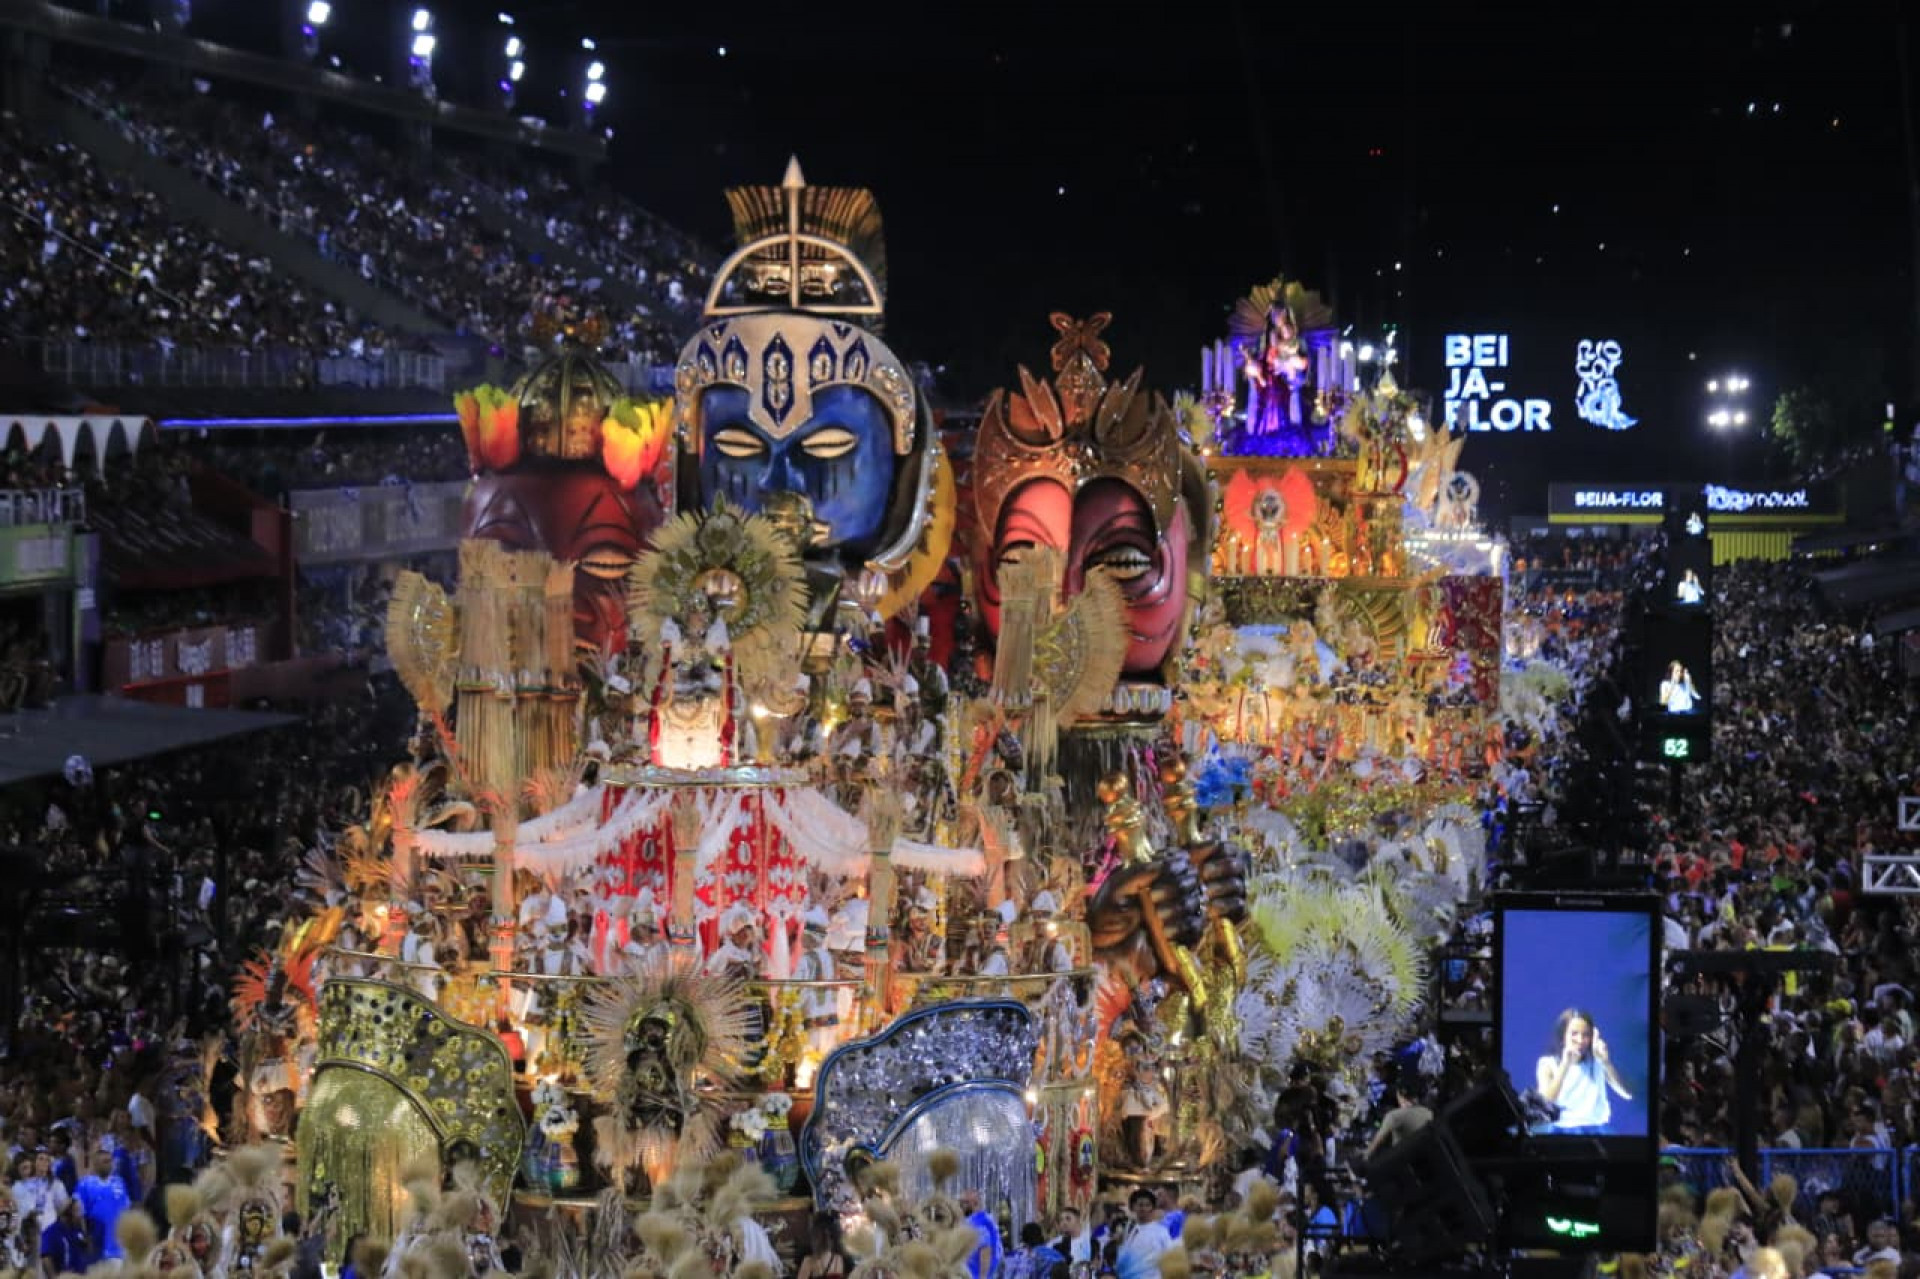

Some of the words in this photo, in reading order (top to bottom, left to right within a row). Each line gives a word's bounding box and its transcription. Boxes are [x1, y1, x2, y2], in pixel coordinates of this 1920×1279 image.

[1445, 334, 1508, 367] BEI
[1444, 367, 1506, 399] JA-
[1445, 399, 1552, 431] FLOR
[1575, 491, 1663, 507] BEIJA-FLOR
